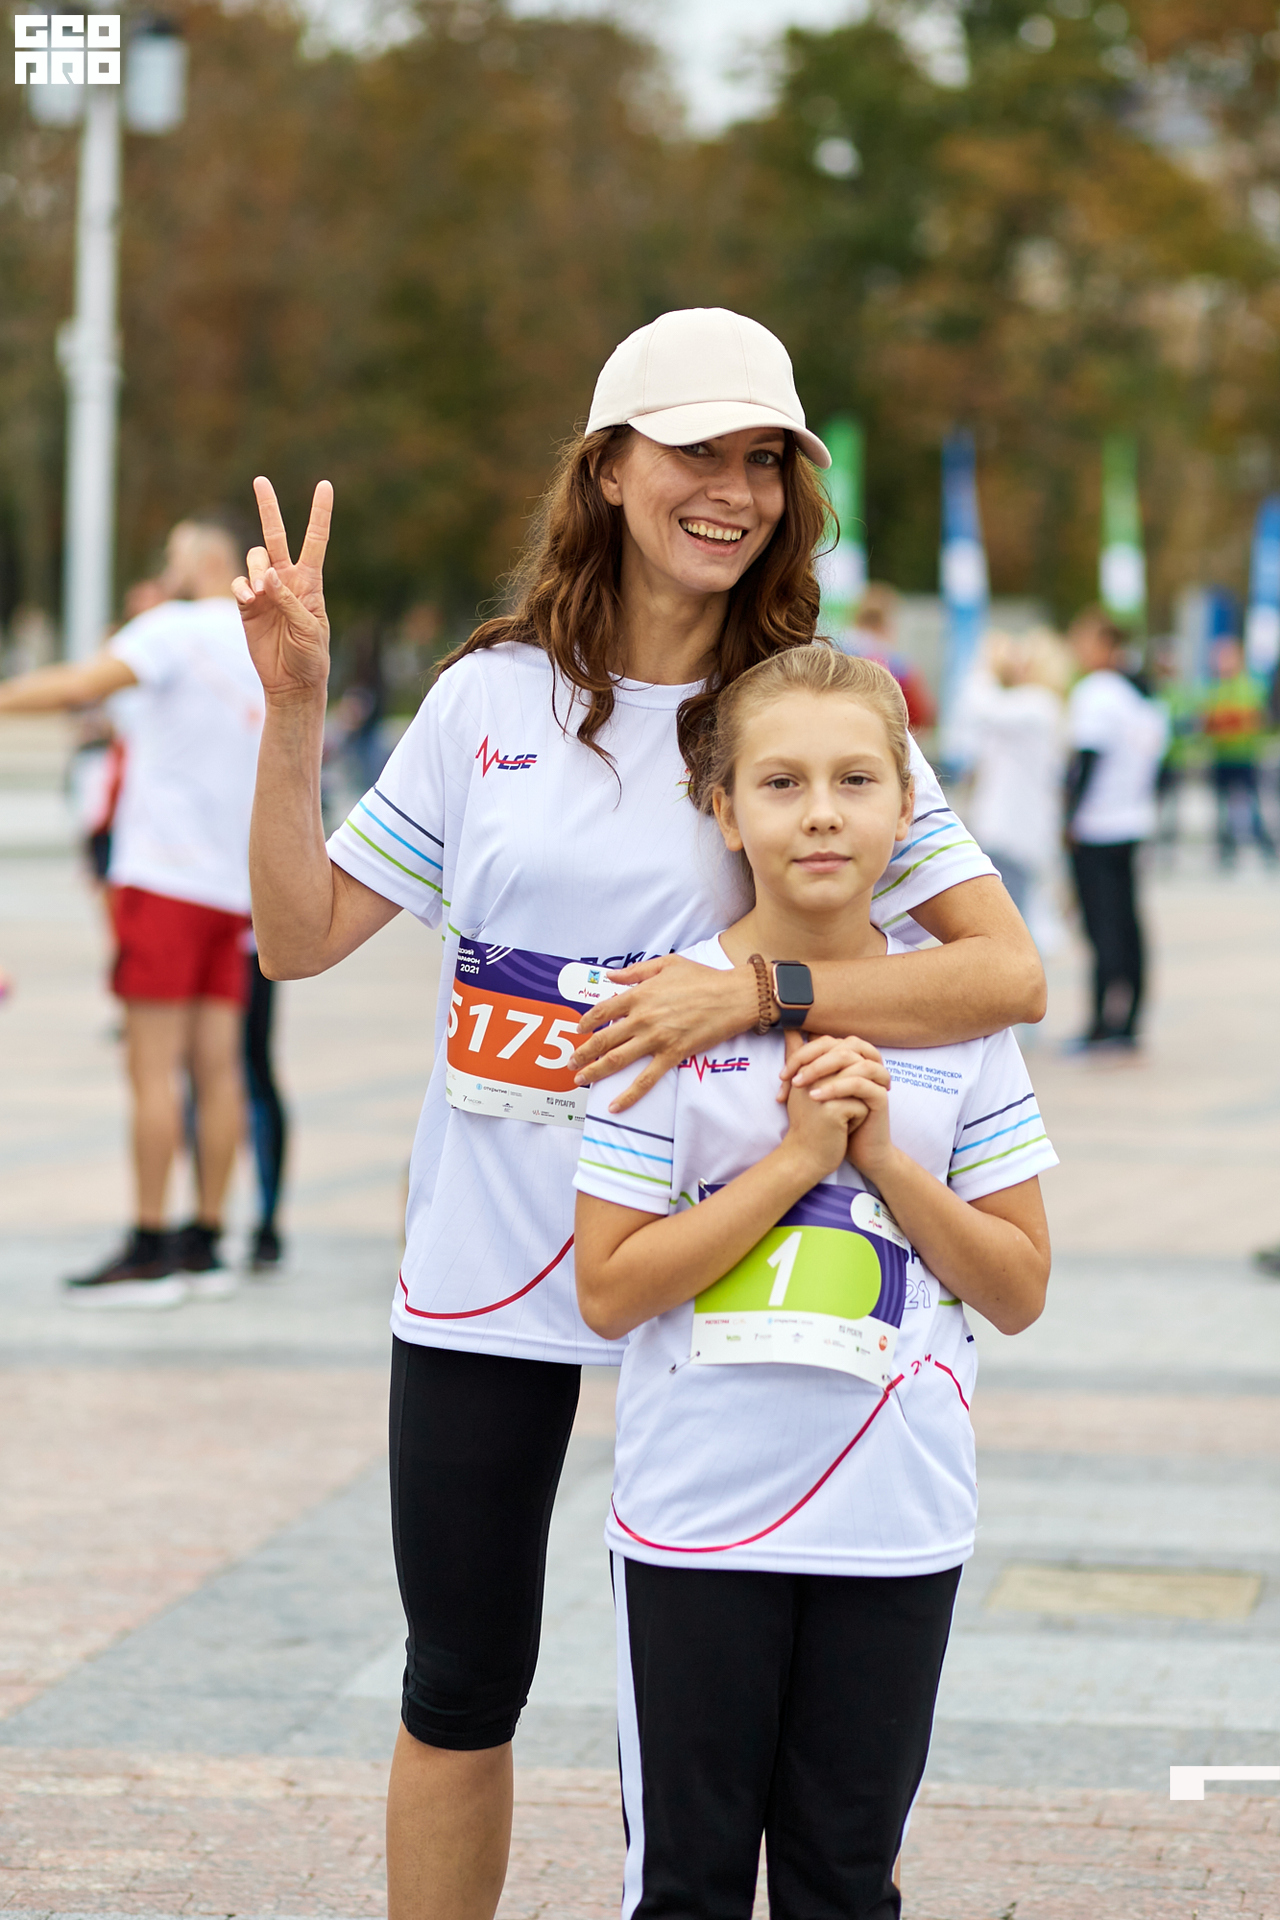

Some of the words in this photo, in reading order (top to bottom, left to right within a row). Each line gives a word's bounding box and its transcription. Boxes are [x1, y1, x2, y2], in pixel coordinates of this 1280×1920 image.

[460, 963, 480, 975] 2021
[447, 988, 580, 1070] 5175
[885, 1059, 924, 1072] УПРАВЛЕНИЕ
[925, 1066, 963, 1079] ФИЗИЧЕСКОЙ
[923, 1074, 945, 1084] СПОРТА
[890, 1075, 932, 1089] ЕЛГОРОДСКОЙ
[933, 1084, 959, 1095] ОБЛАСТИ
[555, 1098, 576, 1109] РУСАГРО
[766, 1231, 803, 1307] 1
